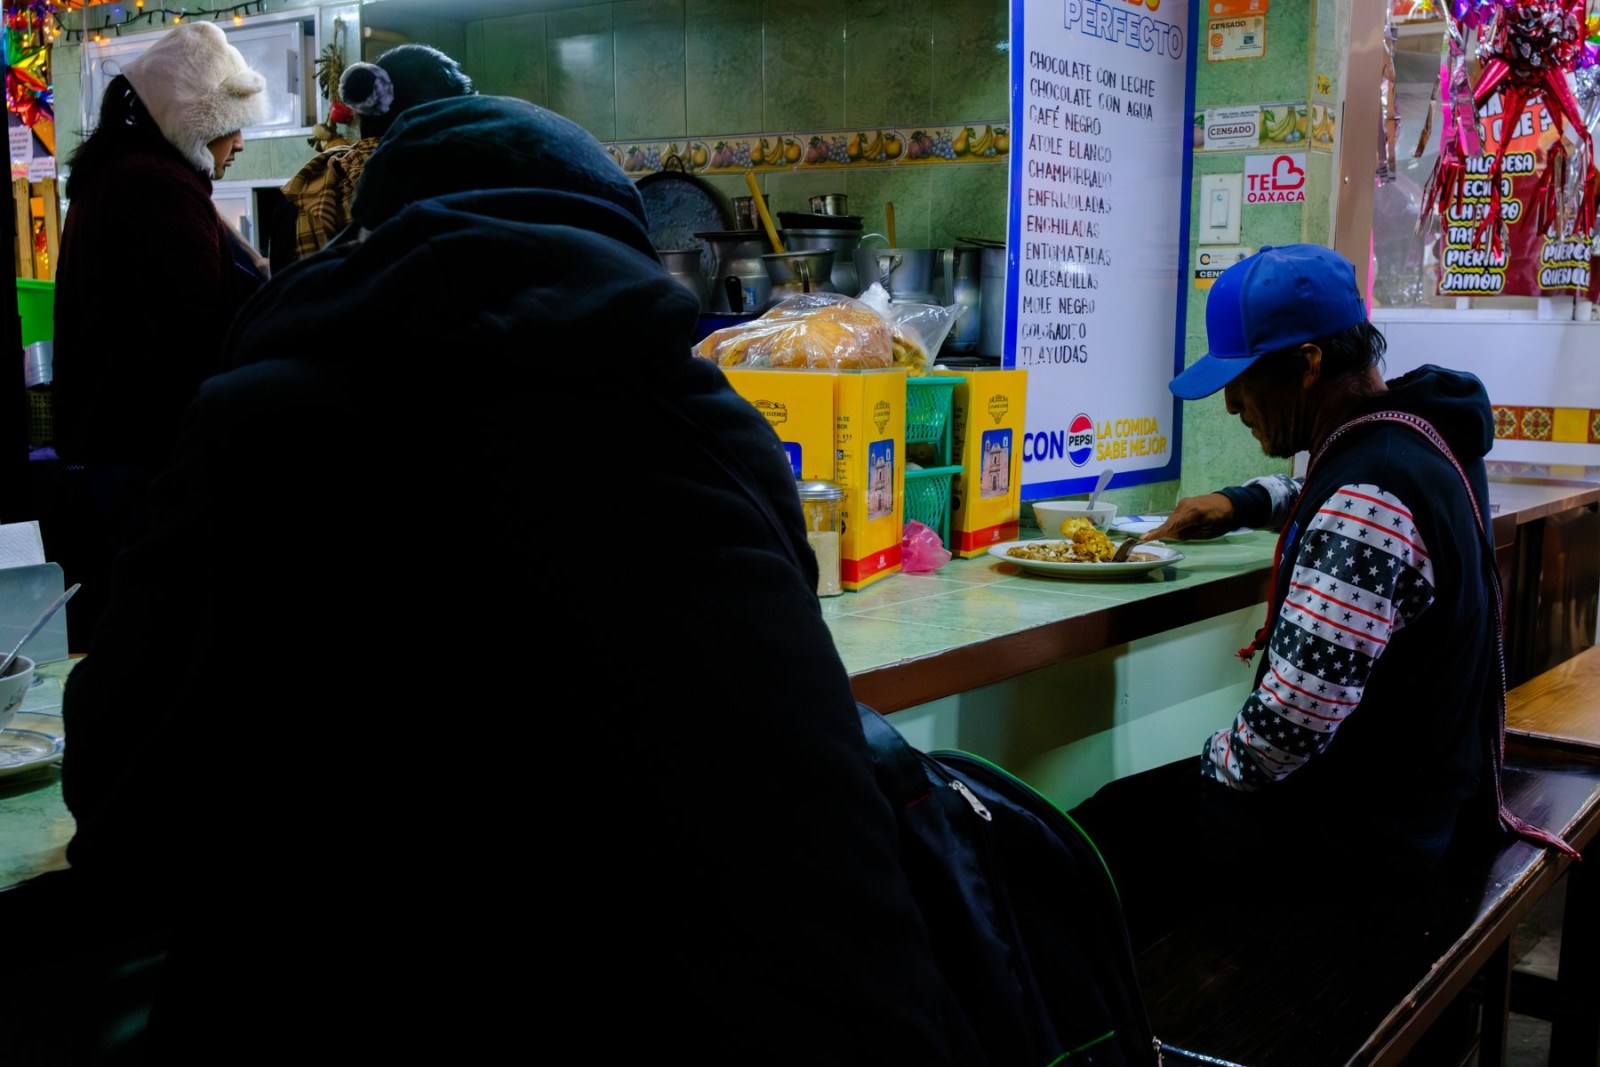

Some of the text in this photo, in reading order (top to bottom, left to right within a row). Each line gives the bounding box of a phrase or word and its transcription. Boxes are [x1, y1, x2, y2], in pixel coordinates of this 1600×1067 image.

[1064, 0, 1183, 60] PERFECTO
[1210, 21, 1246, 30] CENSADO
[1029, 50, 1155, 98] CHOCOLATE CON LECHE
[1030, 78, 1153, 121] CHOCOLATE CON AGUA
[1029, 105, 1101, 136] CAFÉ NEGRO
[1210, 125, 1252, 136] CENSADO
[1028, 134, 1112, 163] ATOLE BLANCO
[1247, 174, 1269, 191] TE
[1247, 190, 1305, 203] OAXACA
[1025, 268, 1099, 290] QUESADILLAS
[1022, 295, 1096, 316] MOLE NEGRO
[1095, 416, 1159, 440] LA COMIDA
[1023, 430, 1093, 462] CON PEPSI
[1095, 435, 1168, 462] SABE MEJOR
